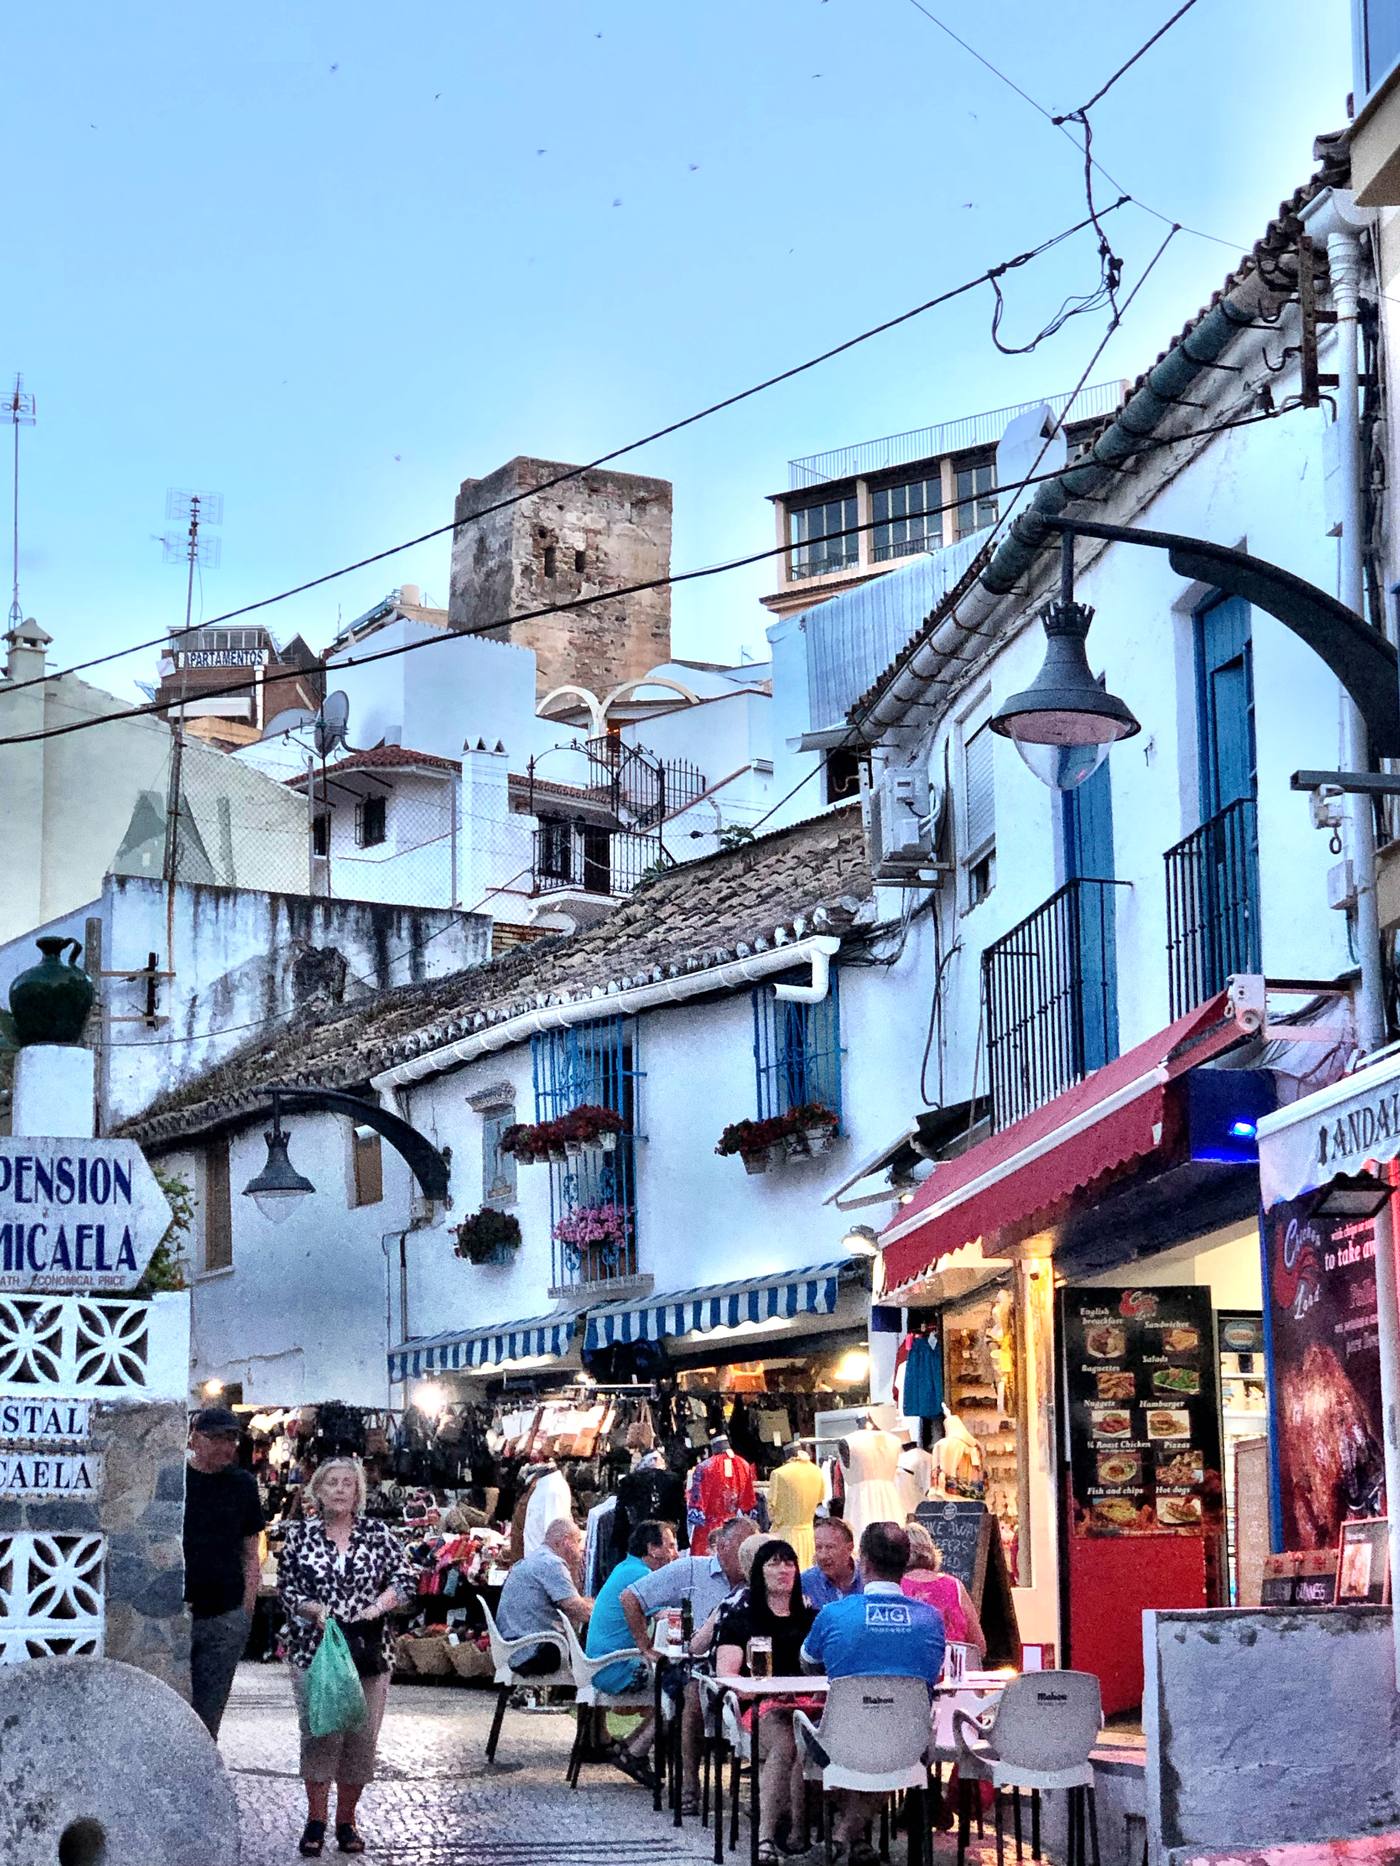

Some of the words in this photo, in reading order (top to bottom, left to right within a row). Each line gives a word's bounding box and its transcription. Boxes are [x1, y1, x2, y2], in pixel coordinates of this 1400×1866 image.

[1325, 1251, 1335, 1271] to
[1337, 1240, 1361, 1267] take
[98, 1275, 126, 1287] PRICE
[1080, 1307, 1110, 1318] English
[1144, 1320, 1190, 1329] Sandwiches
[1142, 1355, 1168, 1363] Salads
[1081, 1364, 1120, 1374] Baguettes
[1084, 1400, 1116, 1409] Nuggets
[1139, 1400, 1185, 1409] Hamburger
[1096, 1440, 1119, 1449] Roast
[1120, 1440, 1151, 1449] Chicken
[1164, 1441, 1191, 1449] Pizzas
[1087, 1487, 1104, 1495] Fish
[1106, 1487, 1121, 1495] and
[1123, 1486, 1144, 1497] chips
[1155, 1486, 1171, 1494] Hot
[1172, 1486, 1191, 1496] dogs
[871, 1607, 904, 1622] AIG
